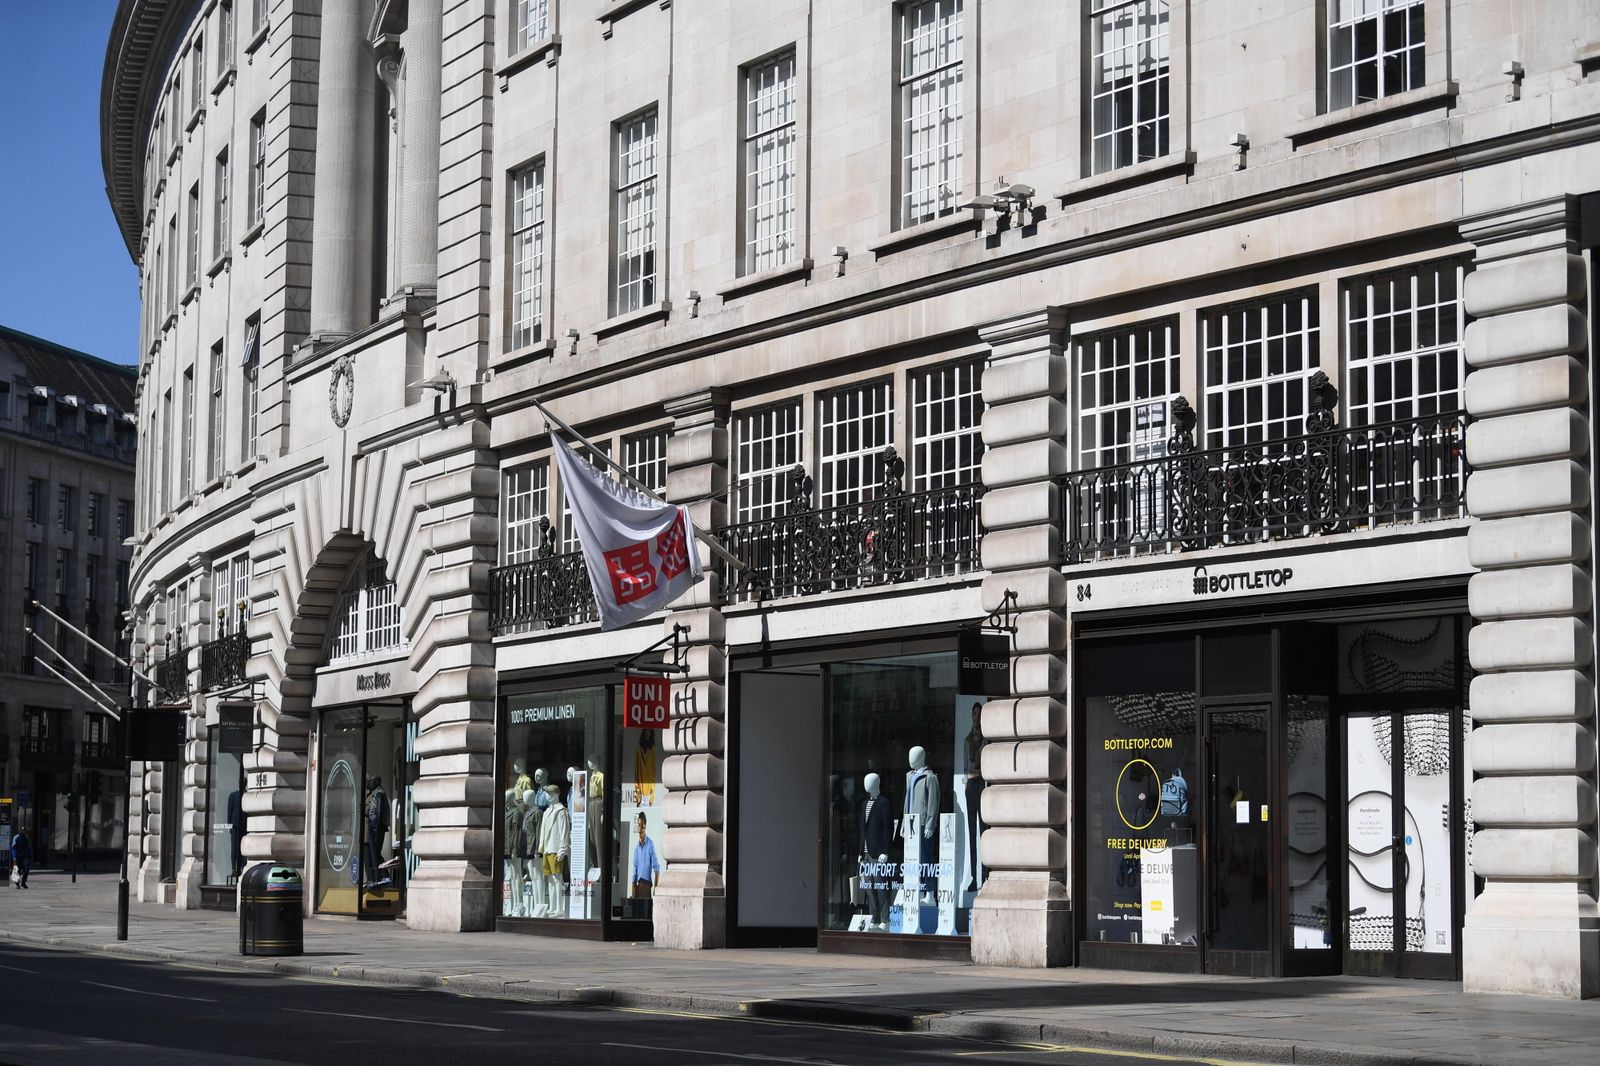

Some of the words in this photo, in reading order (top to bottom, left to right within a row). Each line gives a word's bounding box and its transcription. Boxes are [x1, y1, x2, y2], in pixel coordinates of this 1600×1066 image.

[1209, 568, 1293, 593] BOTTLETOP
[1076, 583, 1092, 601] 84
[970, 661, 1009, 670] BOTTLETOP
[631, 683, 664, 702] UNI
[511, 710, 524, 724] 100%
[525, 706, 554, 722] PREMIUM
[555, 703, 576, 720] LINEN
[631, 704, 665, 724] QLO
[1104, 738, 1173, 750] BOTTLETOP.COM
[1107, 838, 1127, 849] FREE
[1128, 838, 1168, 849] DELIVERY
[859, 863, 897, 877] COMFORT
[899, 863, 954, 878] SMARTWEAR
[859, 880, 872, 889] Work
[873, 881, 889, 890] smart.
